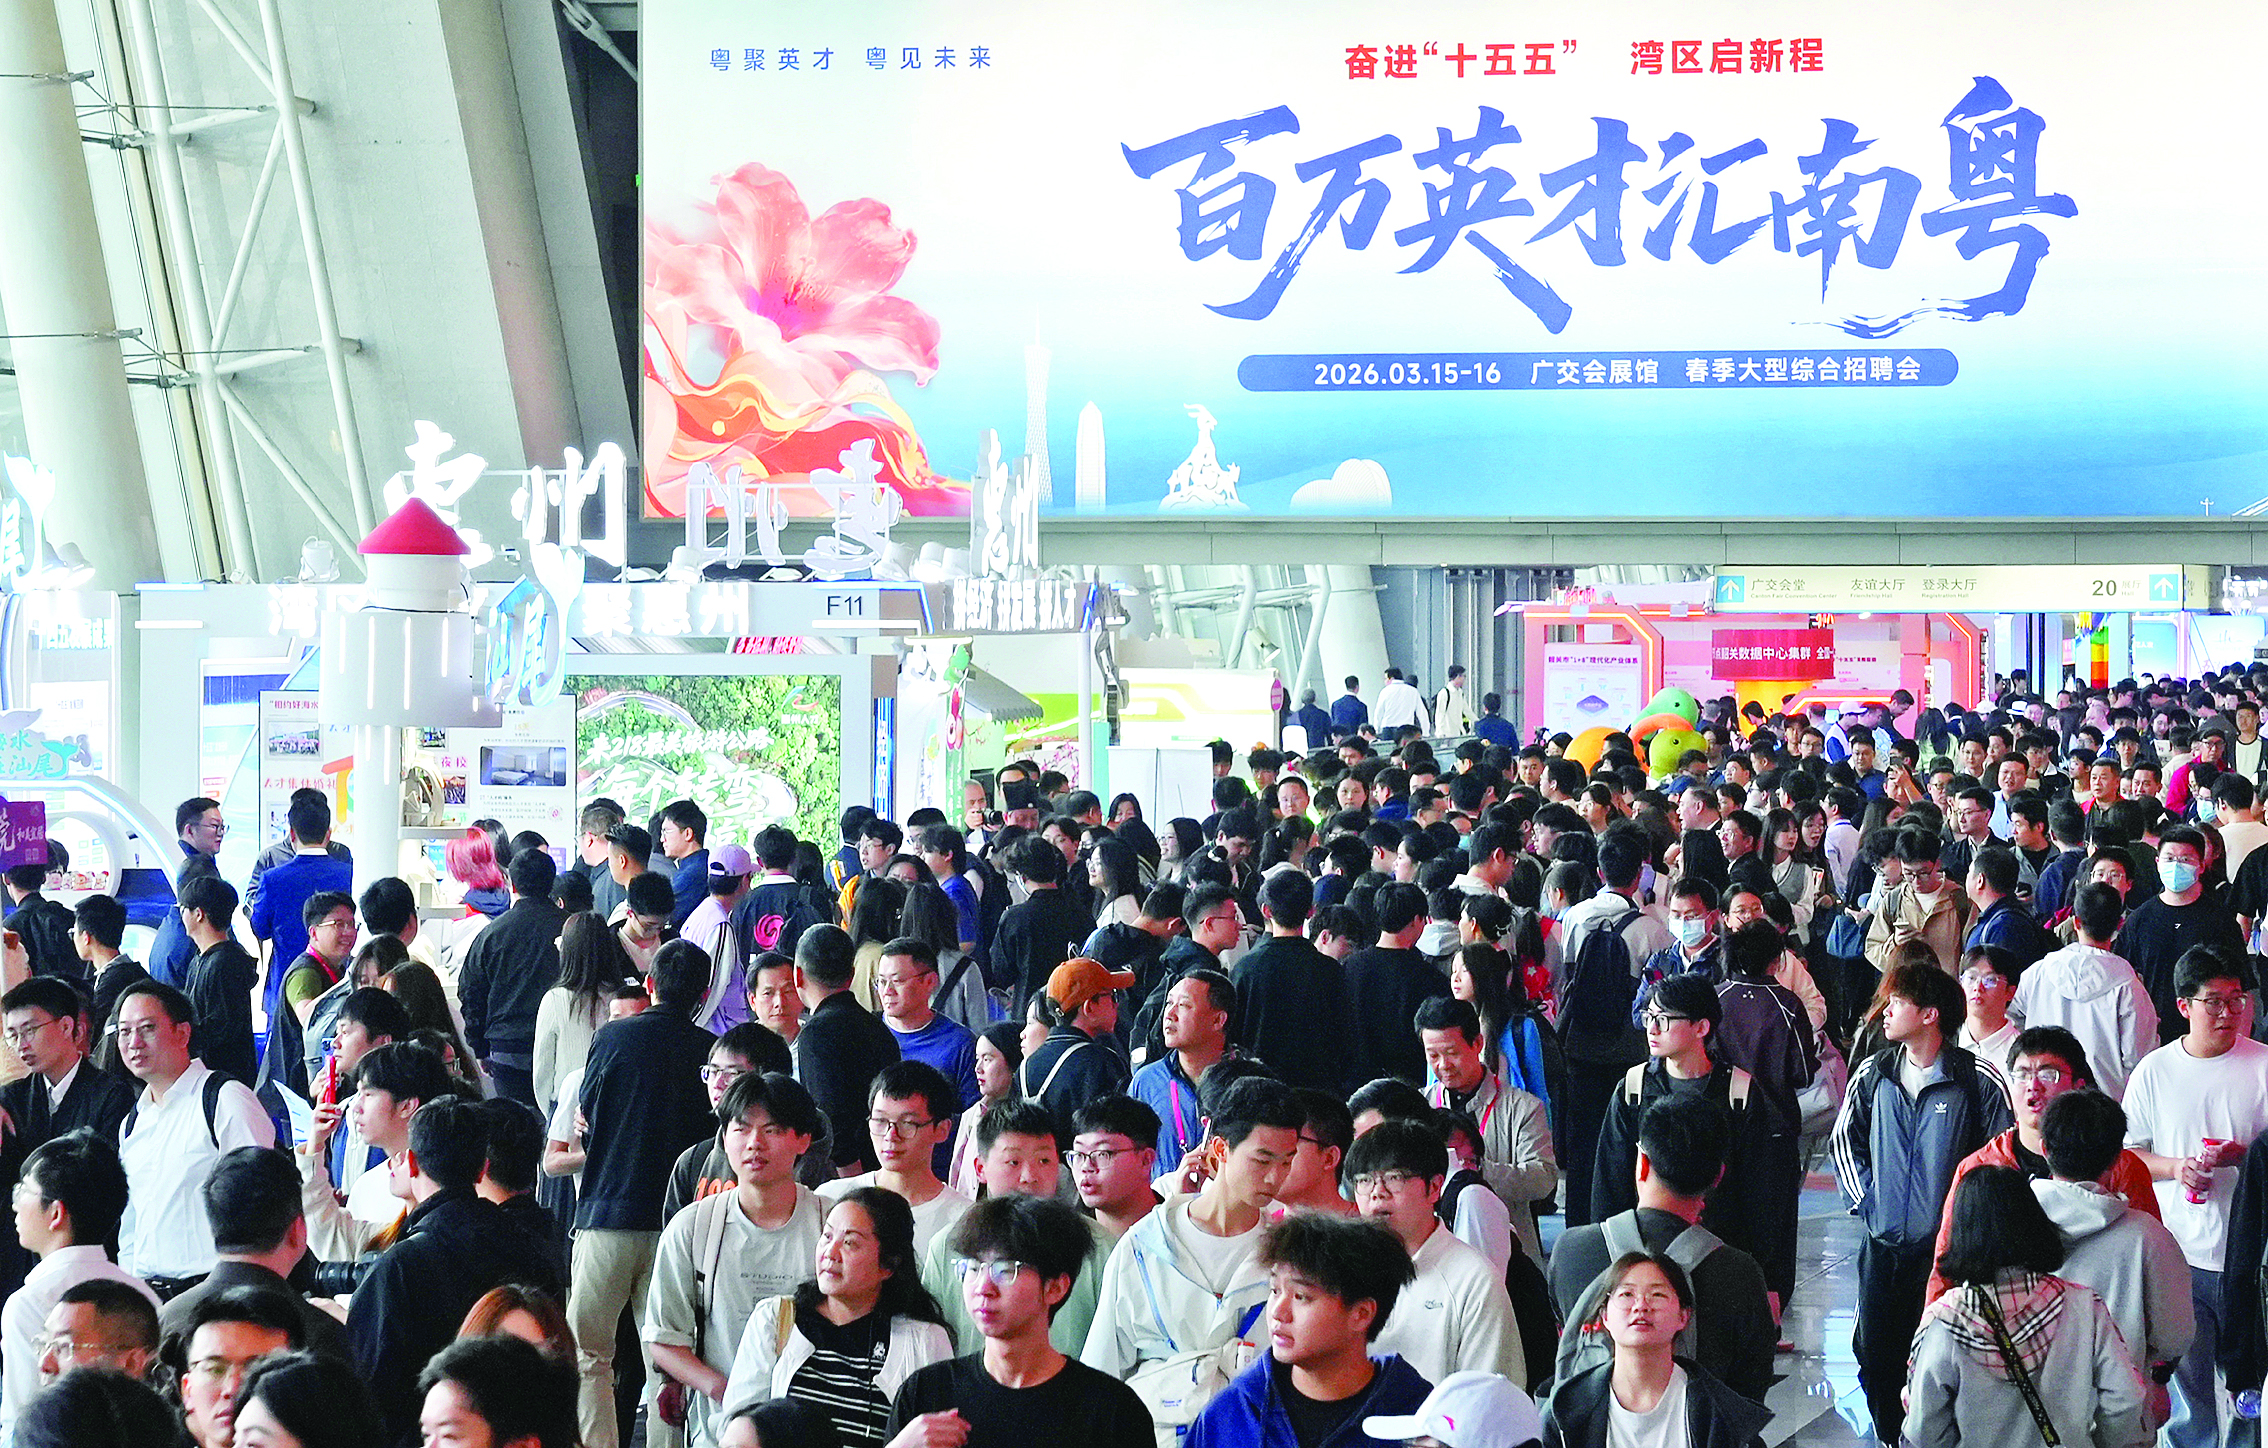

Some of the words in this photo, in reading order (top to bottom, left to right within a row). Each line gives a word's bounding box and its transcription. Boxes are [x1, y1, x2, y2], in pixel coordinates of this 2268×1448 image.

[709, 47, 835, 72] 粤聚英才
[866, 45, 991, 71] 粤见未来
[1345, 39, 1577, 80] 奋进“十五五”
[1630, 37, 1824, 75] 湾区启新程
[1121, 76, 2078, 336] 百万英才汇南粤
[1314, 362, 1501, 385] 2026.03.15-16
[1530, 358, 1659, 385] 广交会展馆
[1685, 355, 1921, 383] 春季大型综合招聘会
[1751, 579, 1806, 591] 广交会堂
[1850, 578, 1906, 591] 友谊大厅
[1922, 578, 1978, 591] 登录大厅
[2091, 579, 2117, 596] 20
[826, 595, 863, 616] F11
